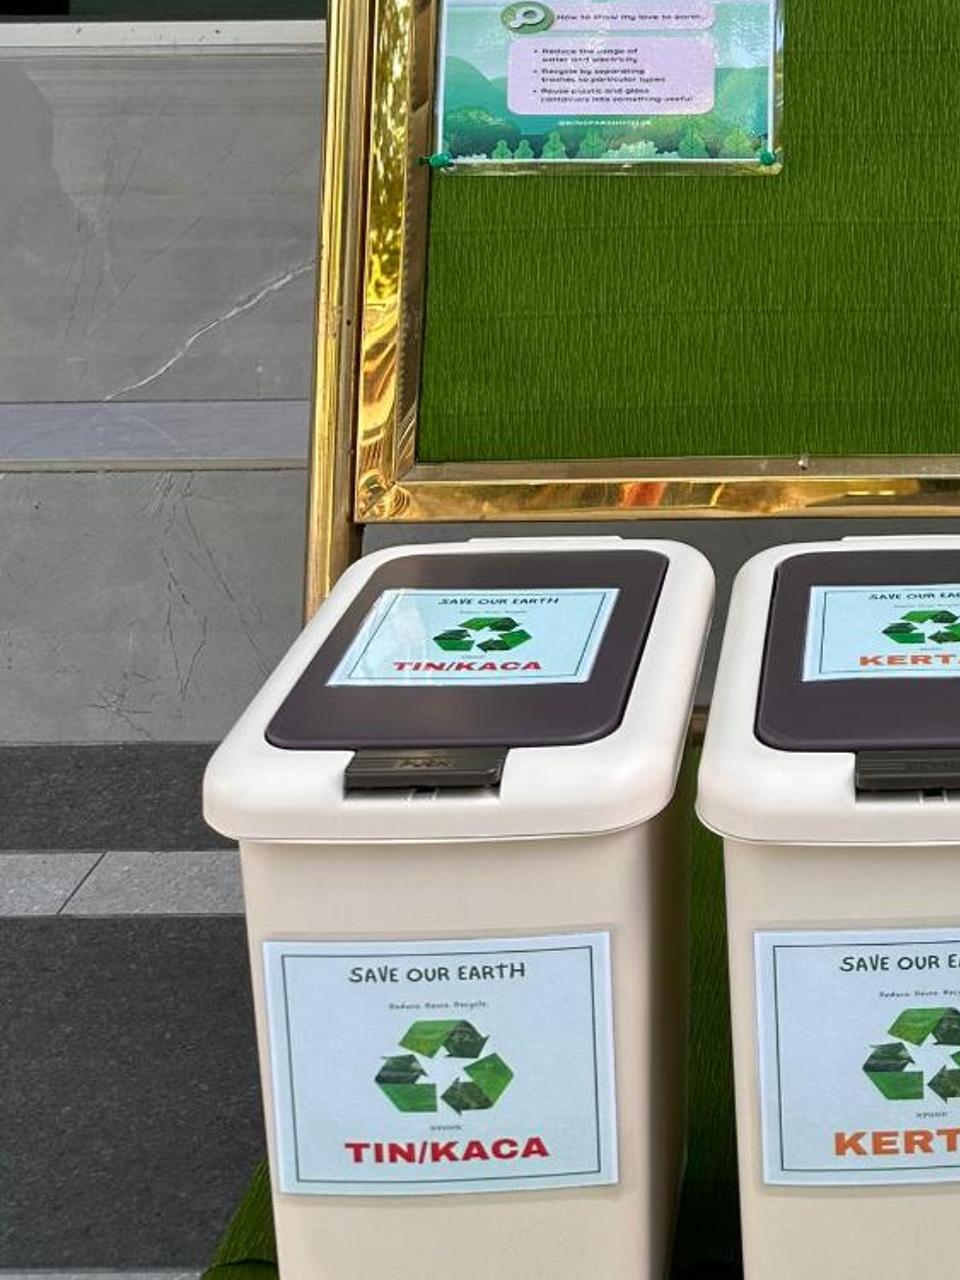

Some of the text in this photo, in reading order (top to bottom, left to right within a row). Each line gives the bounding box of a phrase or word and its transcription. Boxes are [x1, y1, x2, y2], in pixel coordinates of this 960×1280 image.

[438, 596, 561, 606] SAVE OUR EARTH
[867, 592, 902, 601] SAVE
[906, 591, 937, 600] OUR
[393, 661, 542, 672] TIN/KACA
[838, 953, 891, 973] SAVE
[896, 954, 941, 971] OUR
[348, 961, 527, 984] SAVE OUR EARTH
[344, 1135, 550, 1165] TIN/KACA
